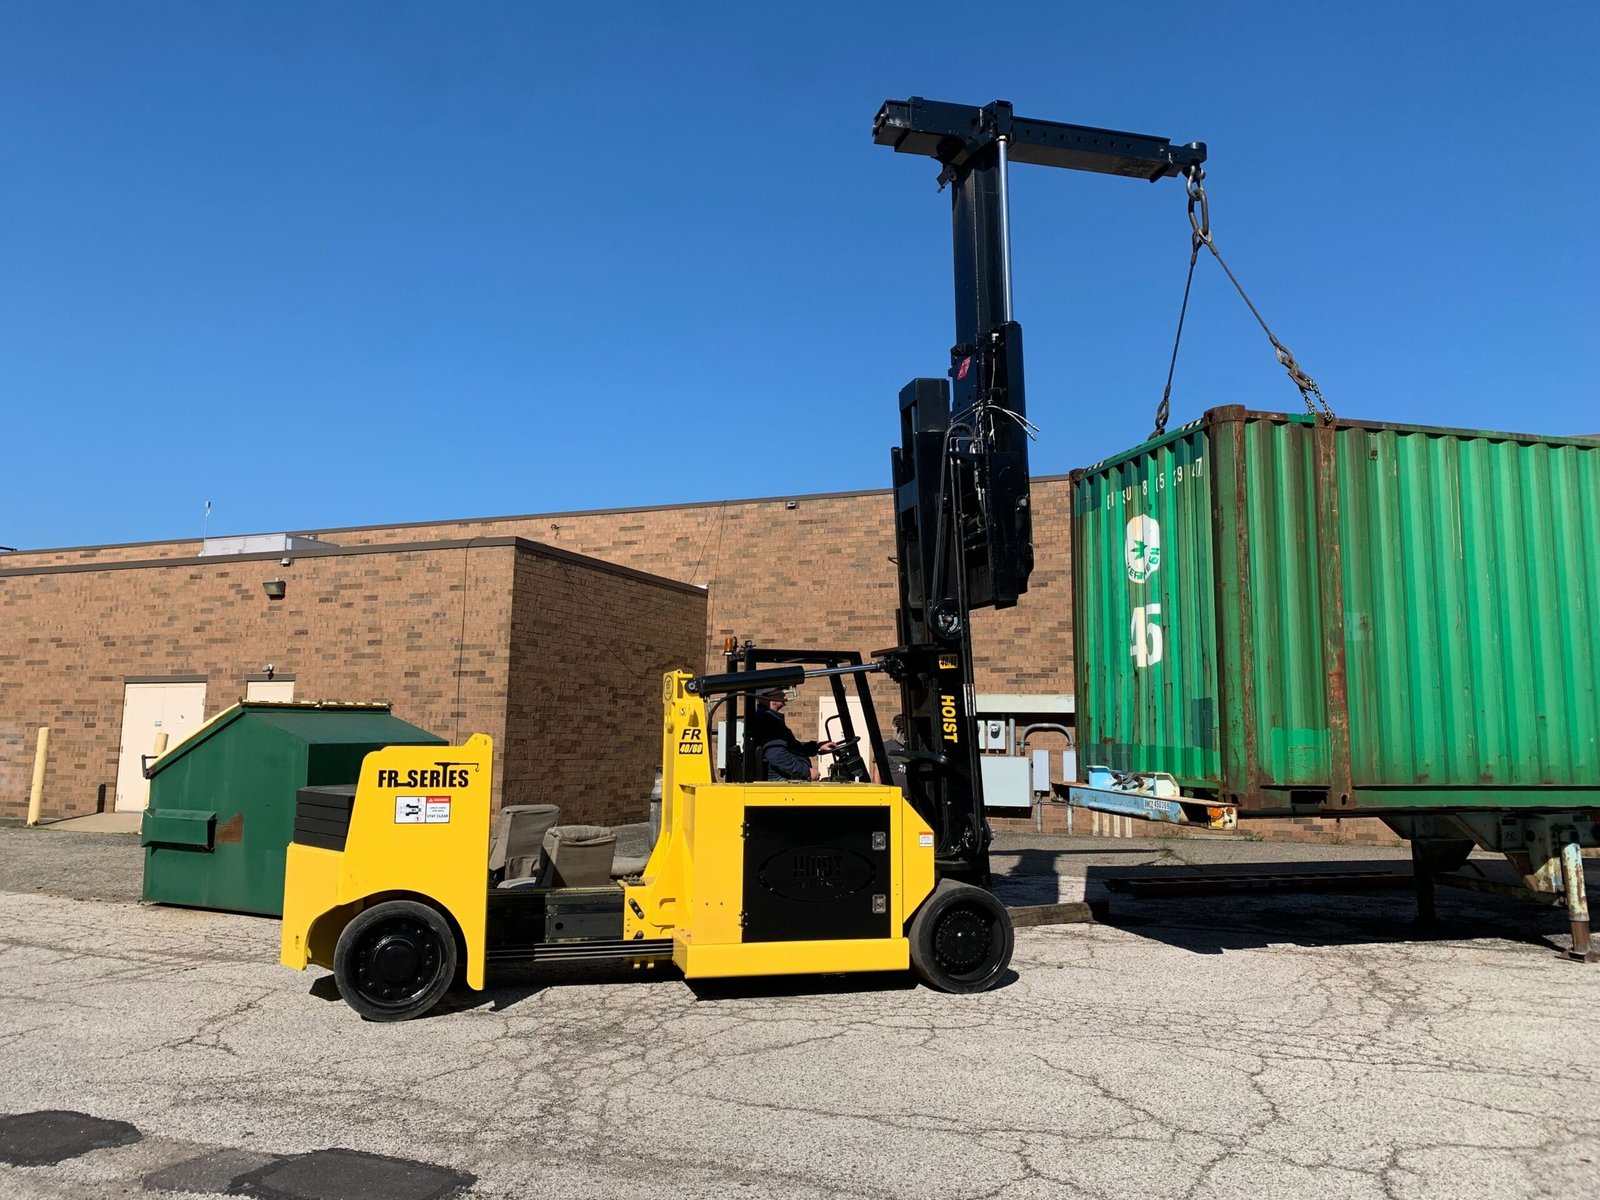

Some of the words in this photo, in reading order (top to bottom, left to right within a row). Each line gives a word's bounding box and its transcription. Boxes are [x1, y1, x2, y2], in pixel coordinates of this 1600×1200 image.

[1130, 603, 1163, 667] 45
[681, 728, 702, 740] FR
[941, 695, 958, 743] HOIST
[377, 769, 399, 788] FR
